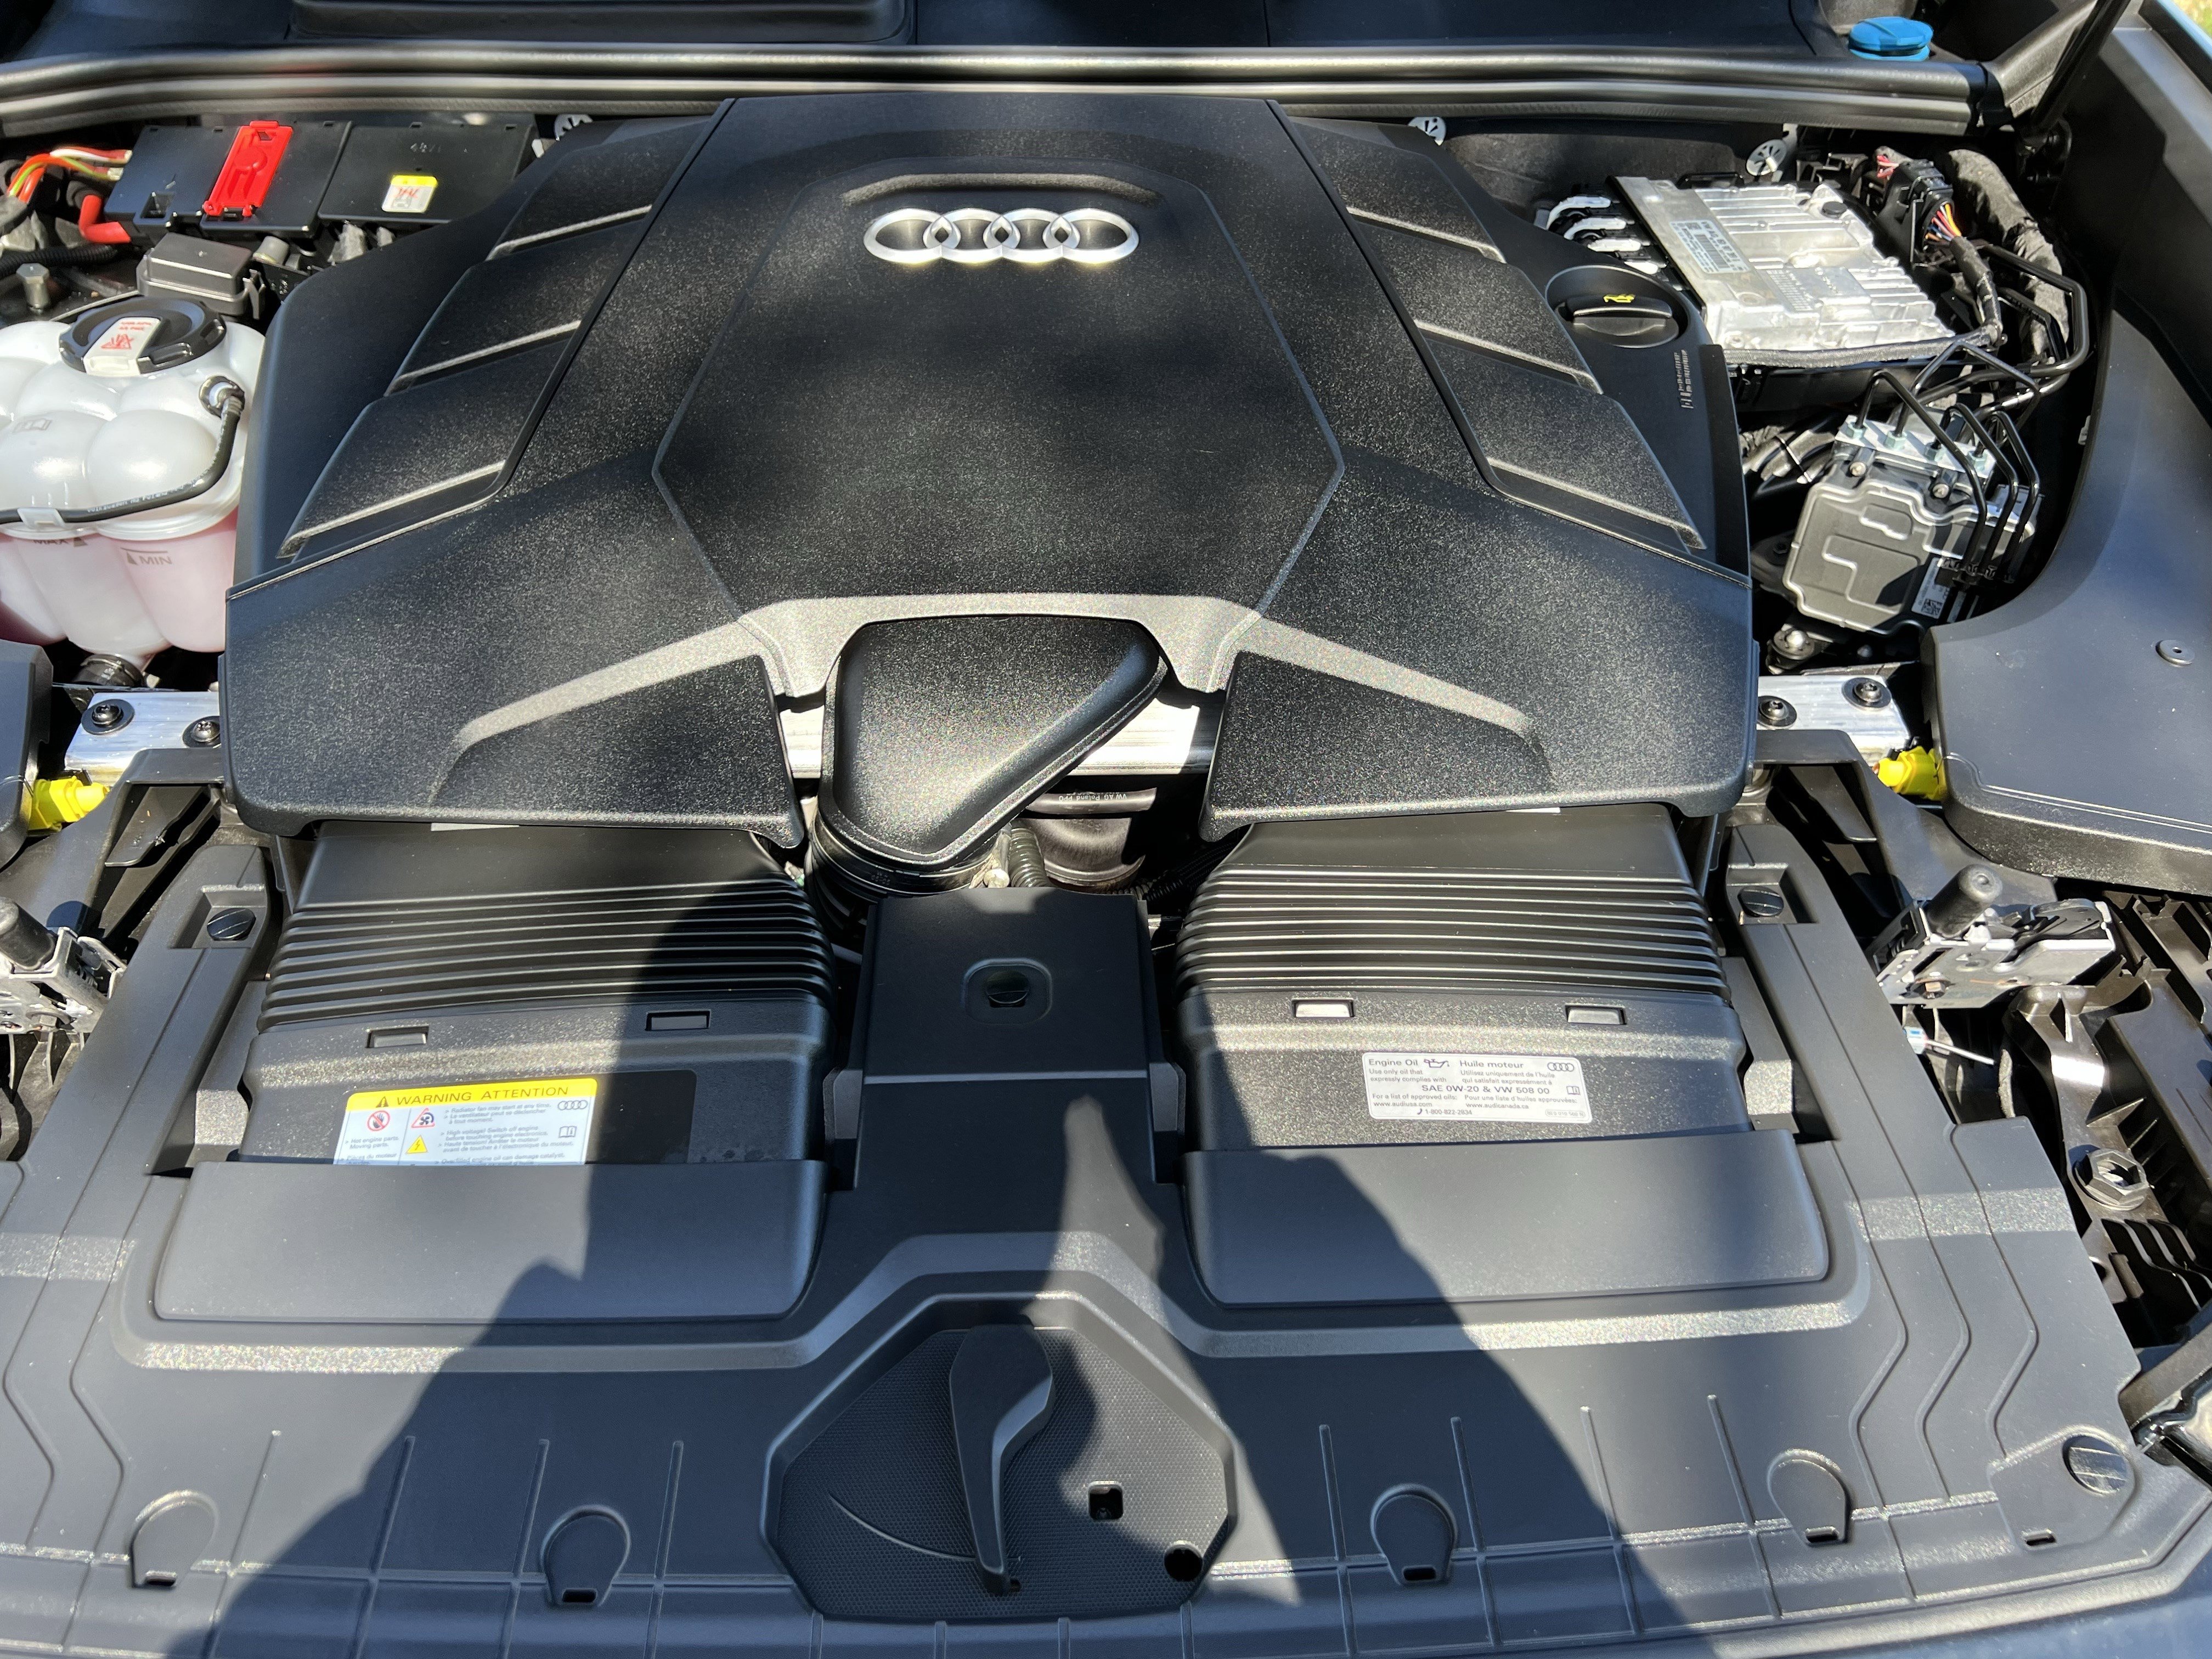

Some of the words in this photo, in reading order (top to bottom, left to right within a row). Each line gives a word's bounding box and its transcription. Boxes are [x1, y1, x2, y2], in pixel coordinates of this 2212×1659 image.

[139, 555, 172, 565] MIN
[397, 1092, 472, 1105] WARNING
[481, 1086, 568, 1100] ATTENTION
